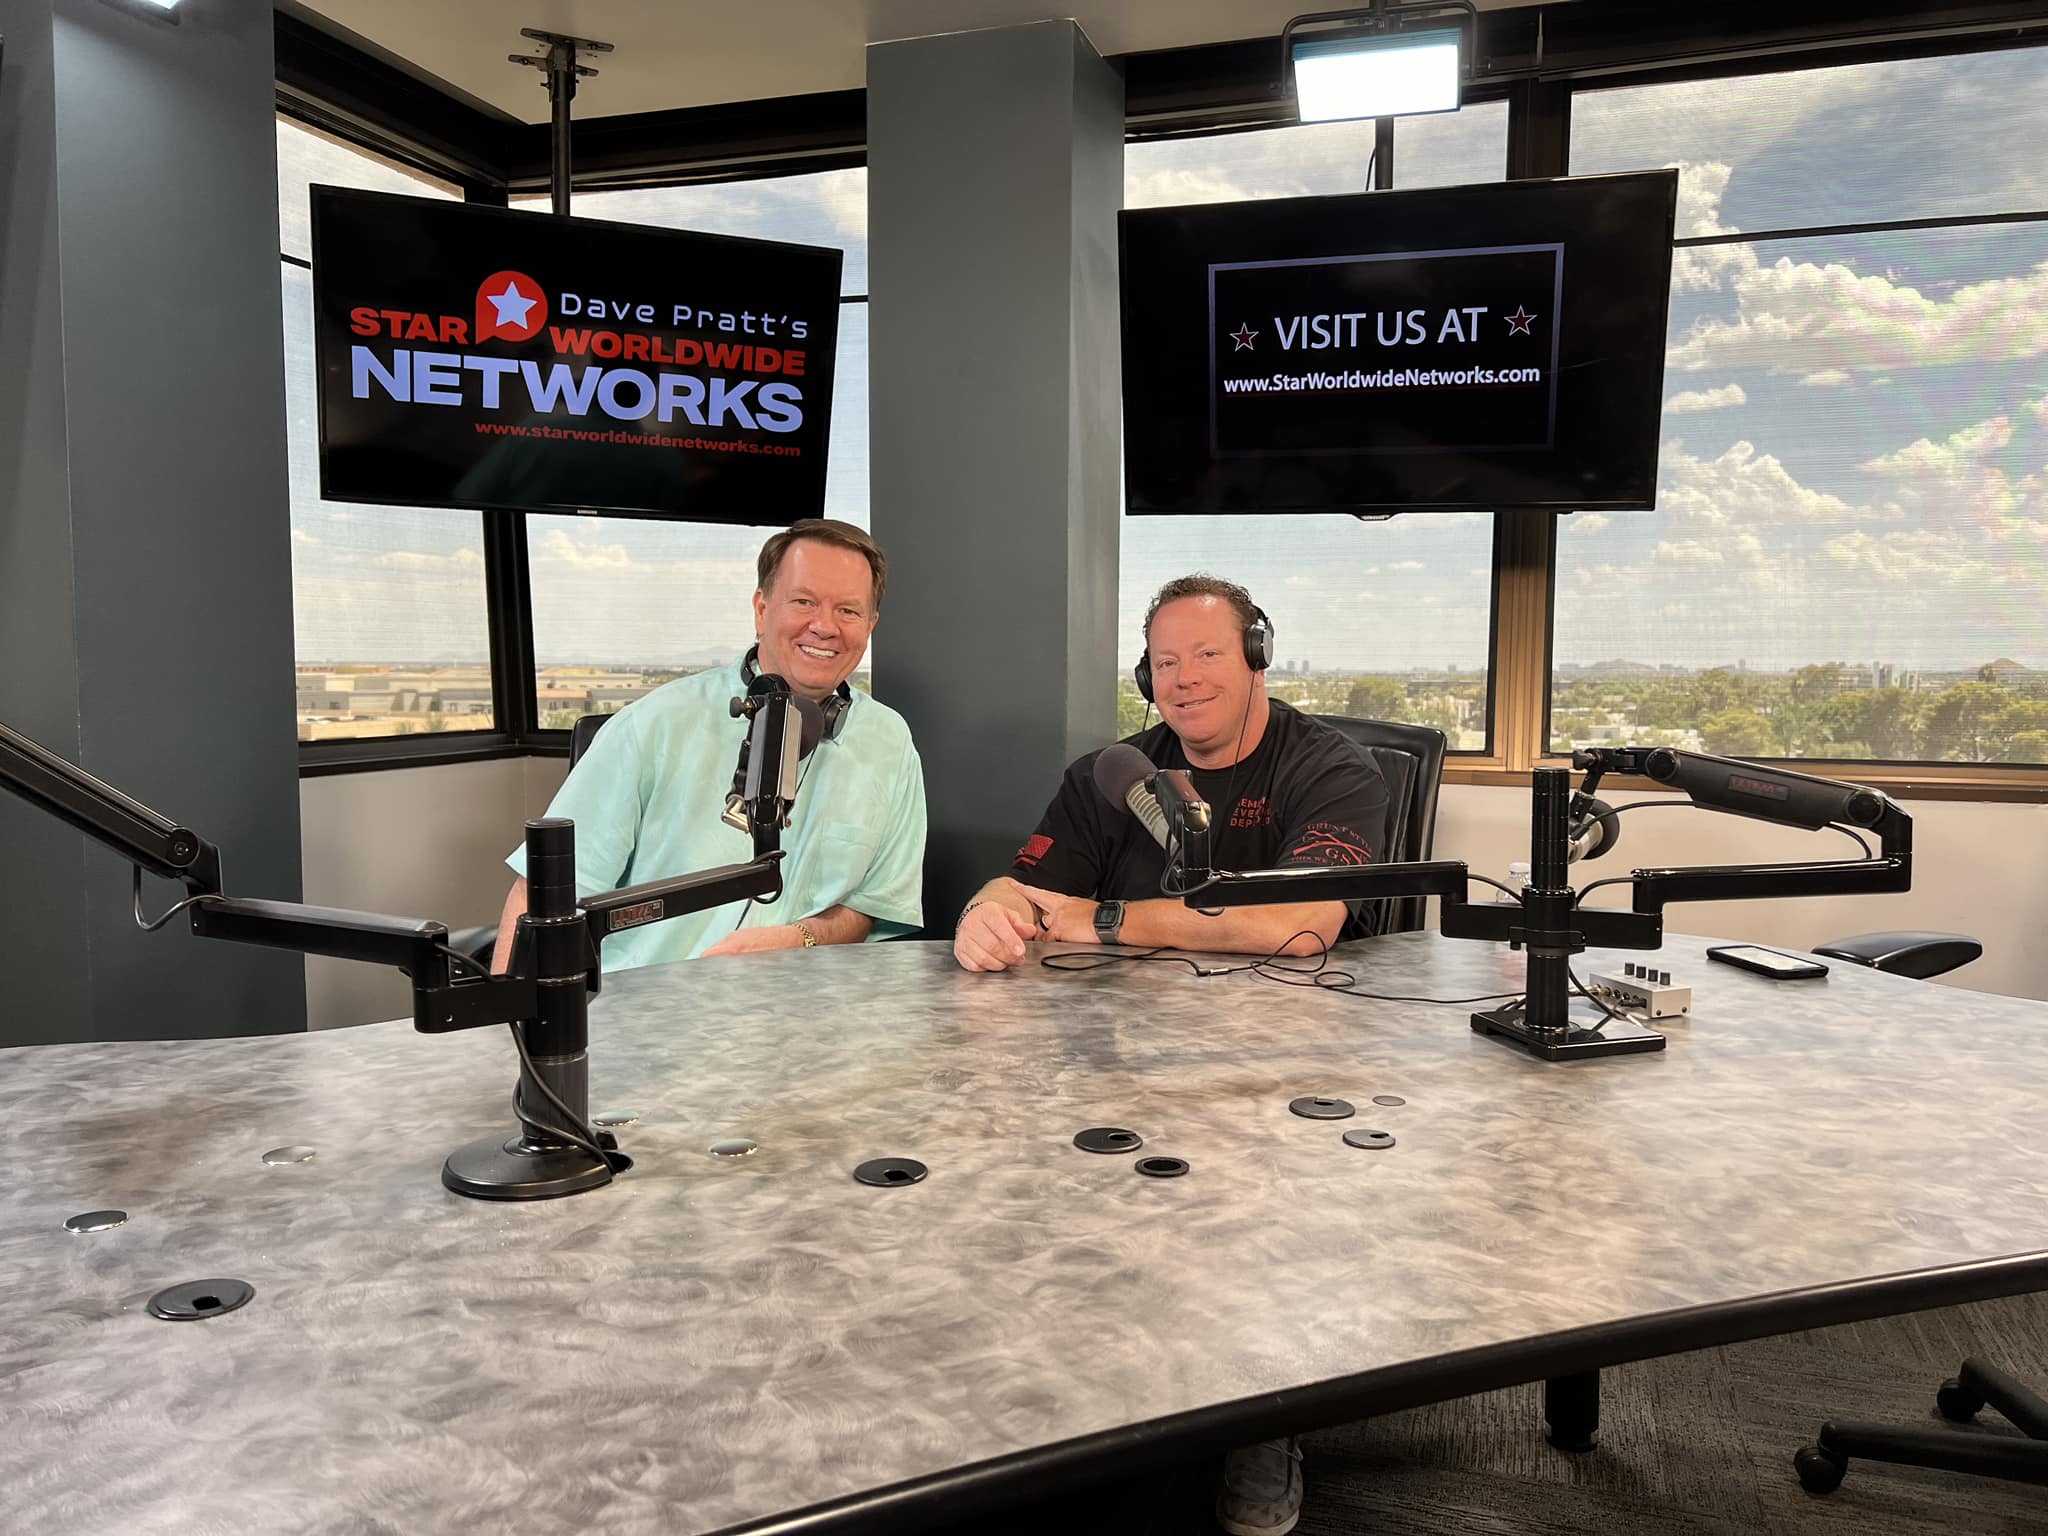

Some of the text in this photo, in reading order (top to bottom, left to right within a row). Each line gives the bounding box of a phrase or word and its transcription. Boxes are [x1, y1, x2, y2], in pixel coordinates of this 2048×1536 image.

[561, 293, 808, 339] Dave Pratt's
[1274, 306, 1488, 350] VISIT US AT
[350, 307, 807, 376] STAR WORLDWIDE
[351, 345, 803, 433] NETWORKS
[1223, 365, 1540, 393] www.StarWorldwideNetworks.com
[474, 422, 801, 457] www.starworldwidenetworks.com
